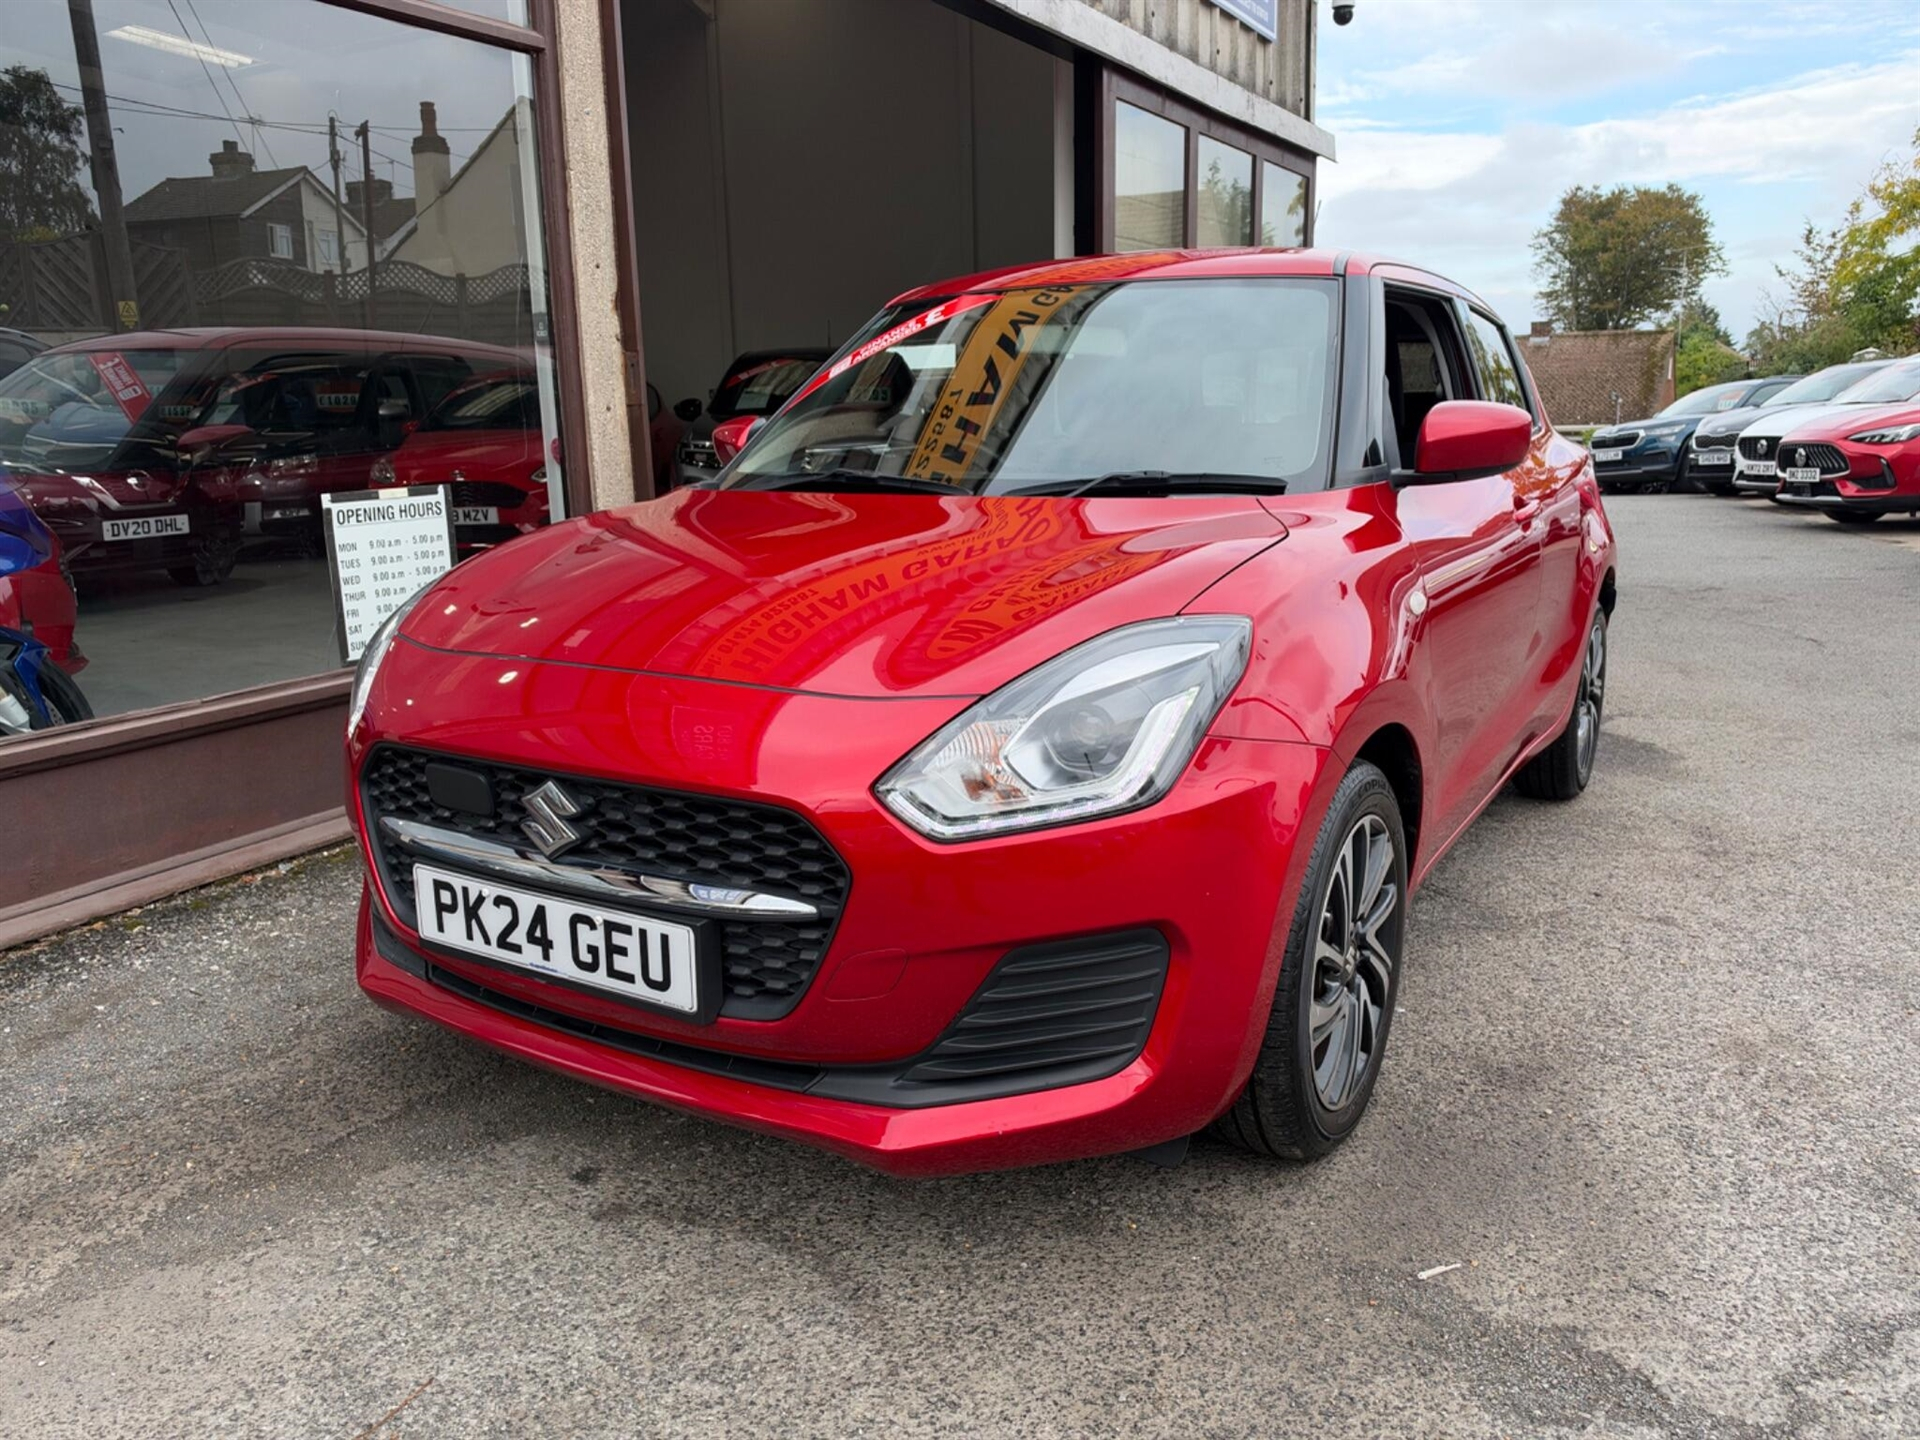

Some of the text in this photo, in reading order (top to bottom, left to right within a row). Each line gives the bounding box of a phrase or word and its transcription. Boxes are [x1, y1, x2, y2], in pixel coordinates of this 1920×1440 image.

[860, 319, 917, 354] FINANCE
[336, 504, 395, 526] OPENING
[399, 501, 443, 519] HOURS
[462, 509, 490, 522] MZV
[110, 517, 184, 538] DV20 DHL
[338, 542, 358, 553] MON
[369, 540, 386, 550] 9.00
[412, 534, 428, 544] 5.00
[340, 558, 361, 570] TUES
[370, 555, 388, 566] 9.00
[413, 549, 430, 560] 5.00
[342, 575, 361, 586] WED
[372, 571, 390, 582] 9.00
[415, 566, 432, 576] 5.00
[344, 590, 367, 602] THUR
[374, 587, 391, 598] 9.00
[346, 608, 360, 619] FRI
[376, 603, 394, 614] 9.00
[348, 624, 363, 636] SAT
[350, 640, 367, 652] SUN
[432, 878, 671, 993] PK24 GEU
